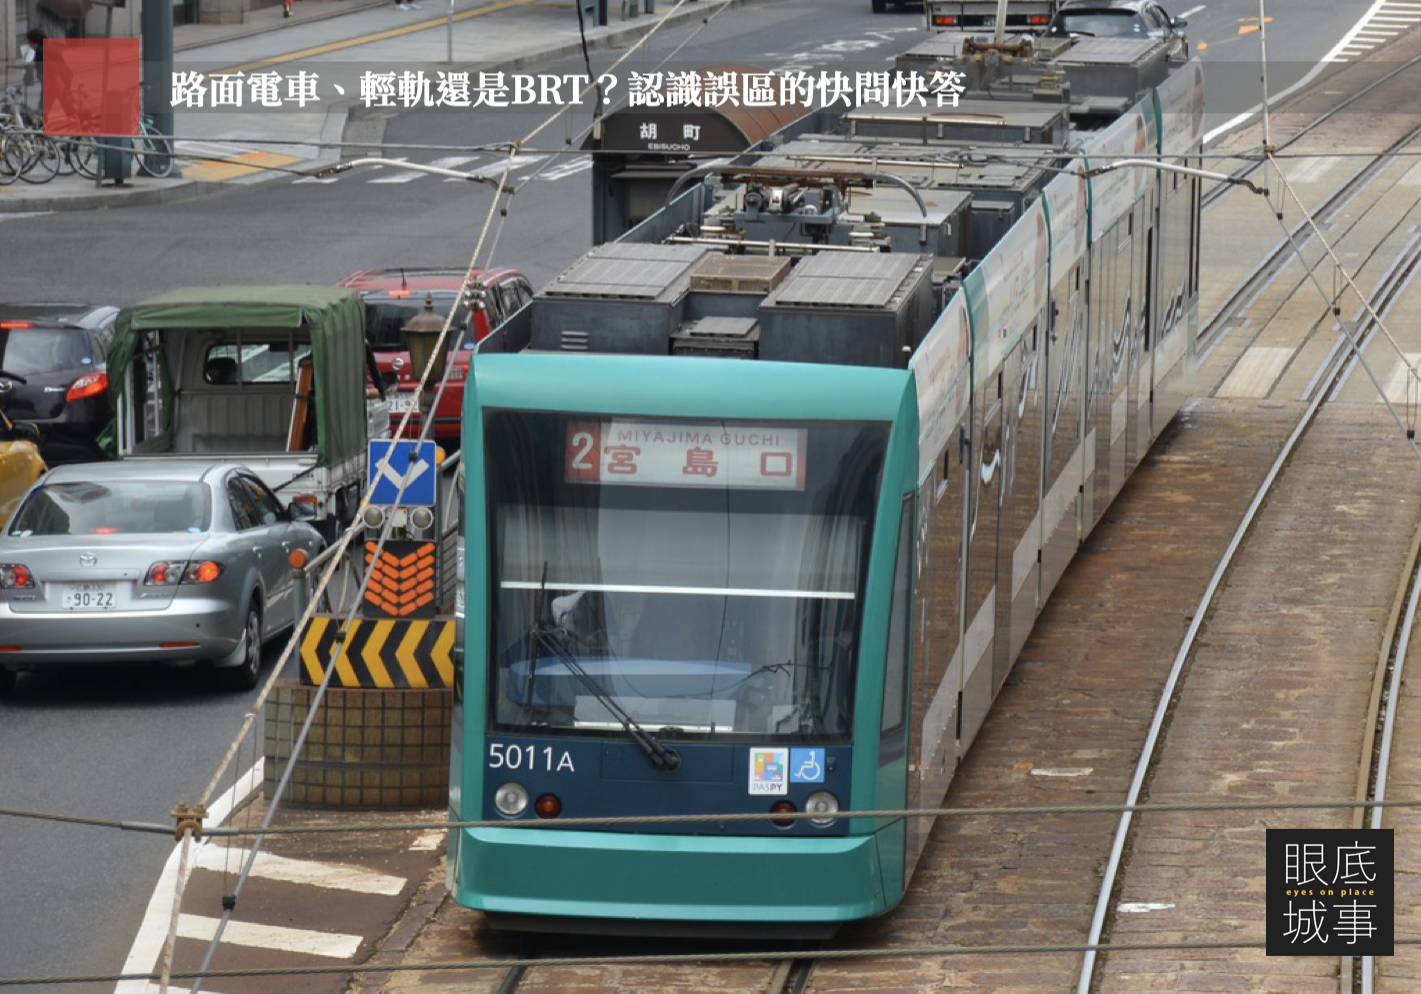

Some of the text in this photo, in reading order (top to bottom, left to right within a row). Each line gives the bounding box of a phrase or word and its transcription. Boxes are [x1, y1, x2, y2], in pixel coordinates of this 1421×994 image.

[640, 122, 701, 141] 胡町
[647, 142, 691, 151] EBISUCHO
[618, 429, 780, 446] MIYAJIMA GUCHI
[572, 432, 594, 470] 2
[604, 444, 793, 478] 宮島口
[74, 592, 113, 606] 90-22
[488, 743, 575, 772] 5011A
[754, 782, 783, 791] PASPY
